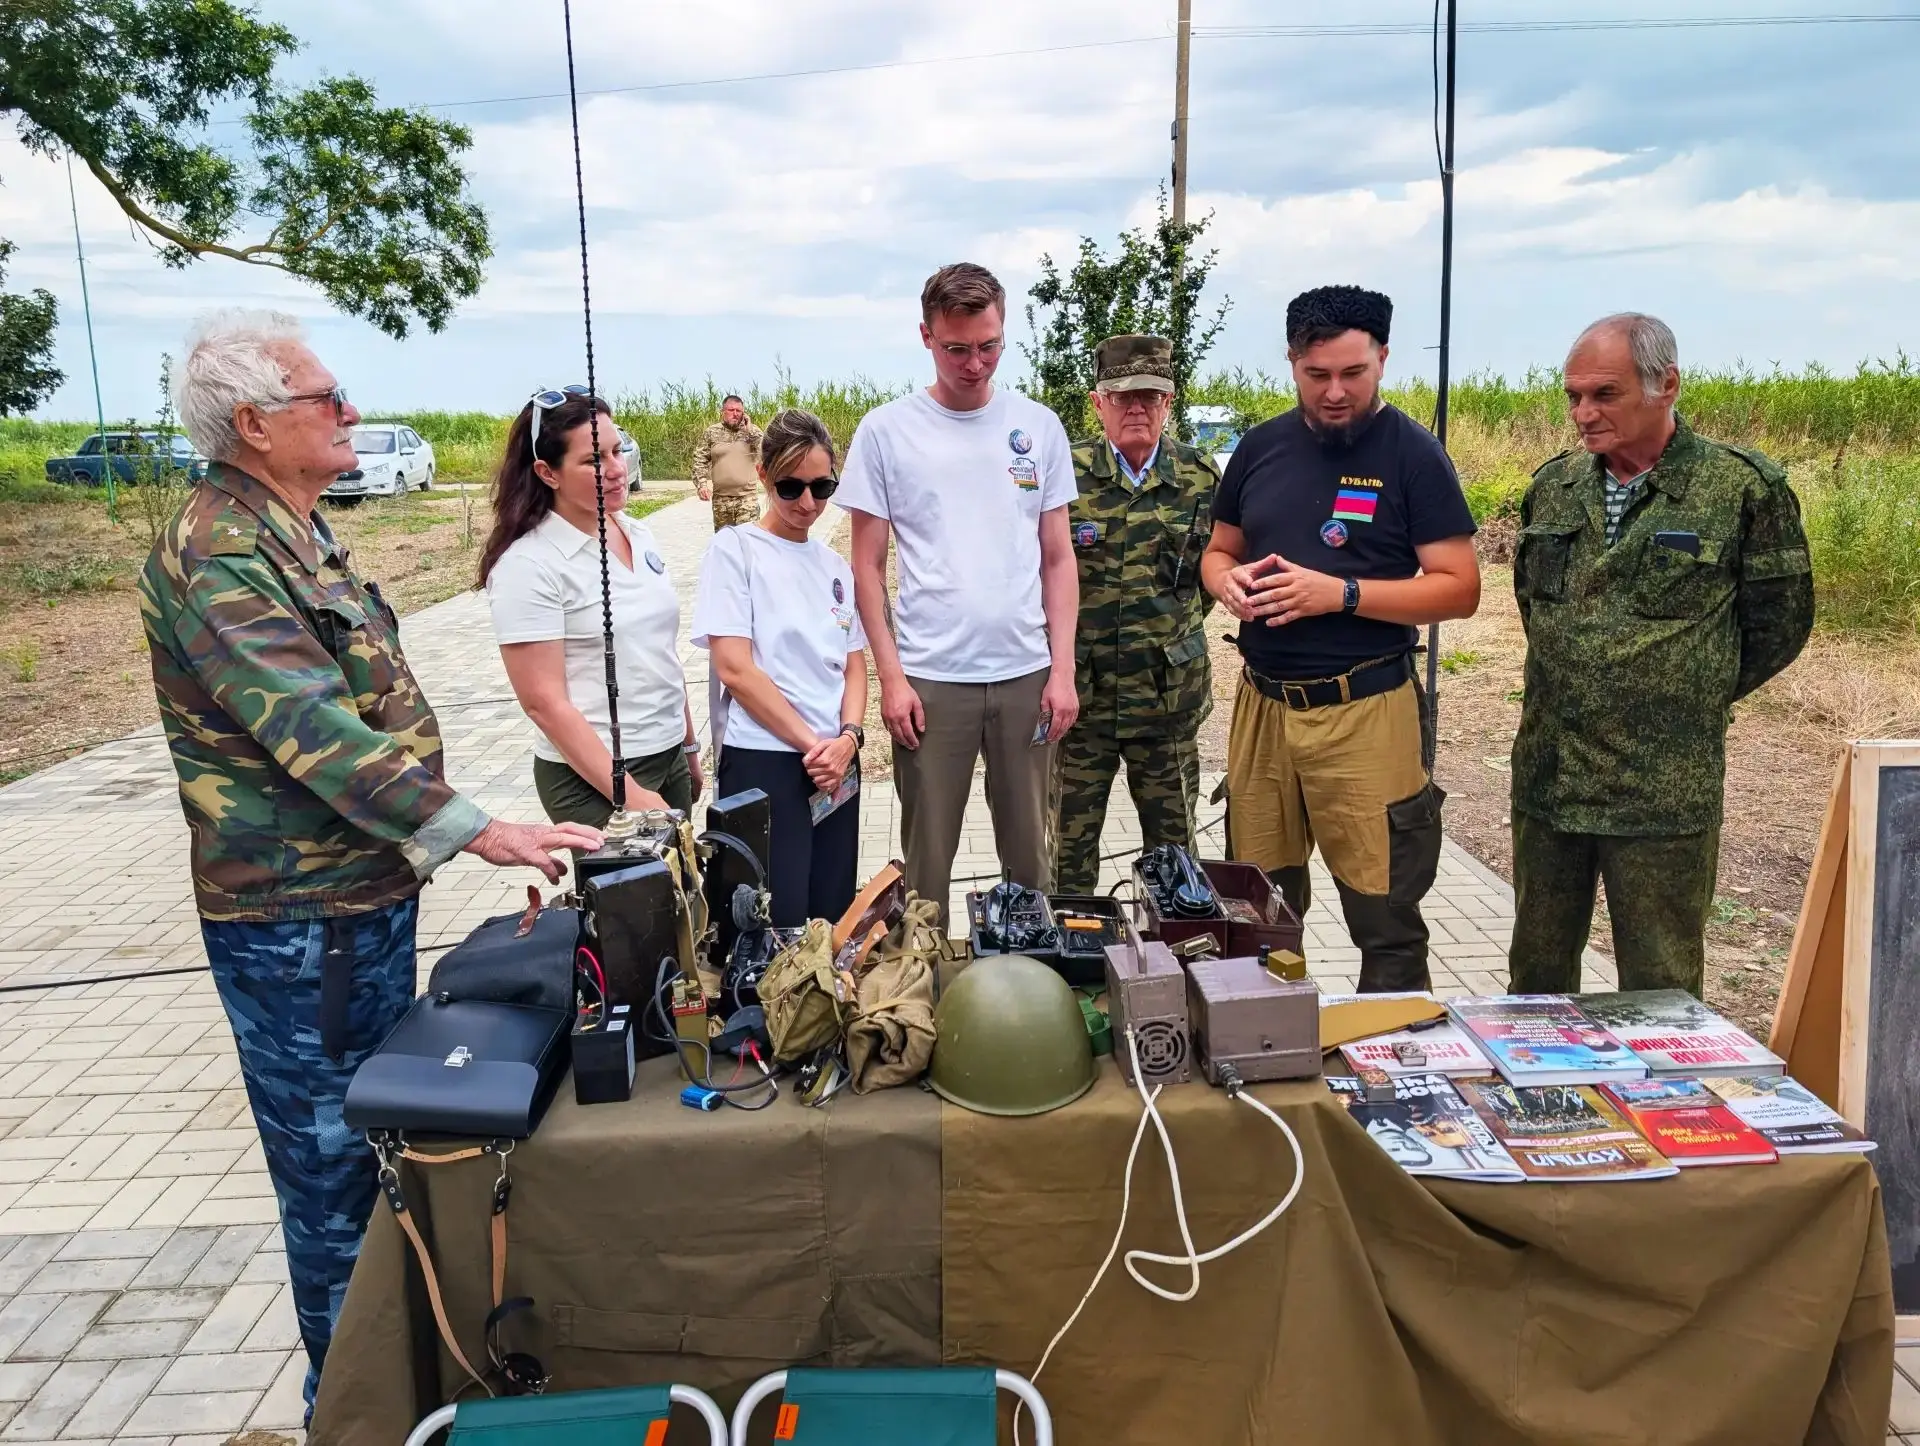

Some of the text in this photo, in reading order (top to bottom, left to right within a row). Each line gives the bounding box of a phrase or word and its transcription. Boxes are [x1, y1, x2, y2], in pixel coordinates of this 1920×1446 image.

[1340, 476, 1384, 488] КУБАНЬ
[1626, 1032, 1756, 1051] ОТЕЧЕСТВЕННАЯ
[1667, 1047, 1750, 1064] ВЕЛИКАЯ
[1395, 1083, 1454, 1100] МОЙ
[1673, 1132, 1738, 1144] НА ОГНЕННОЙ
